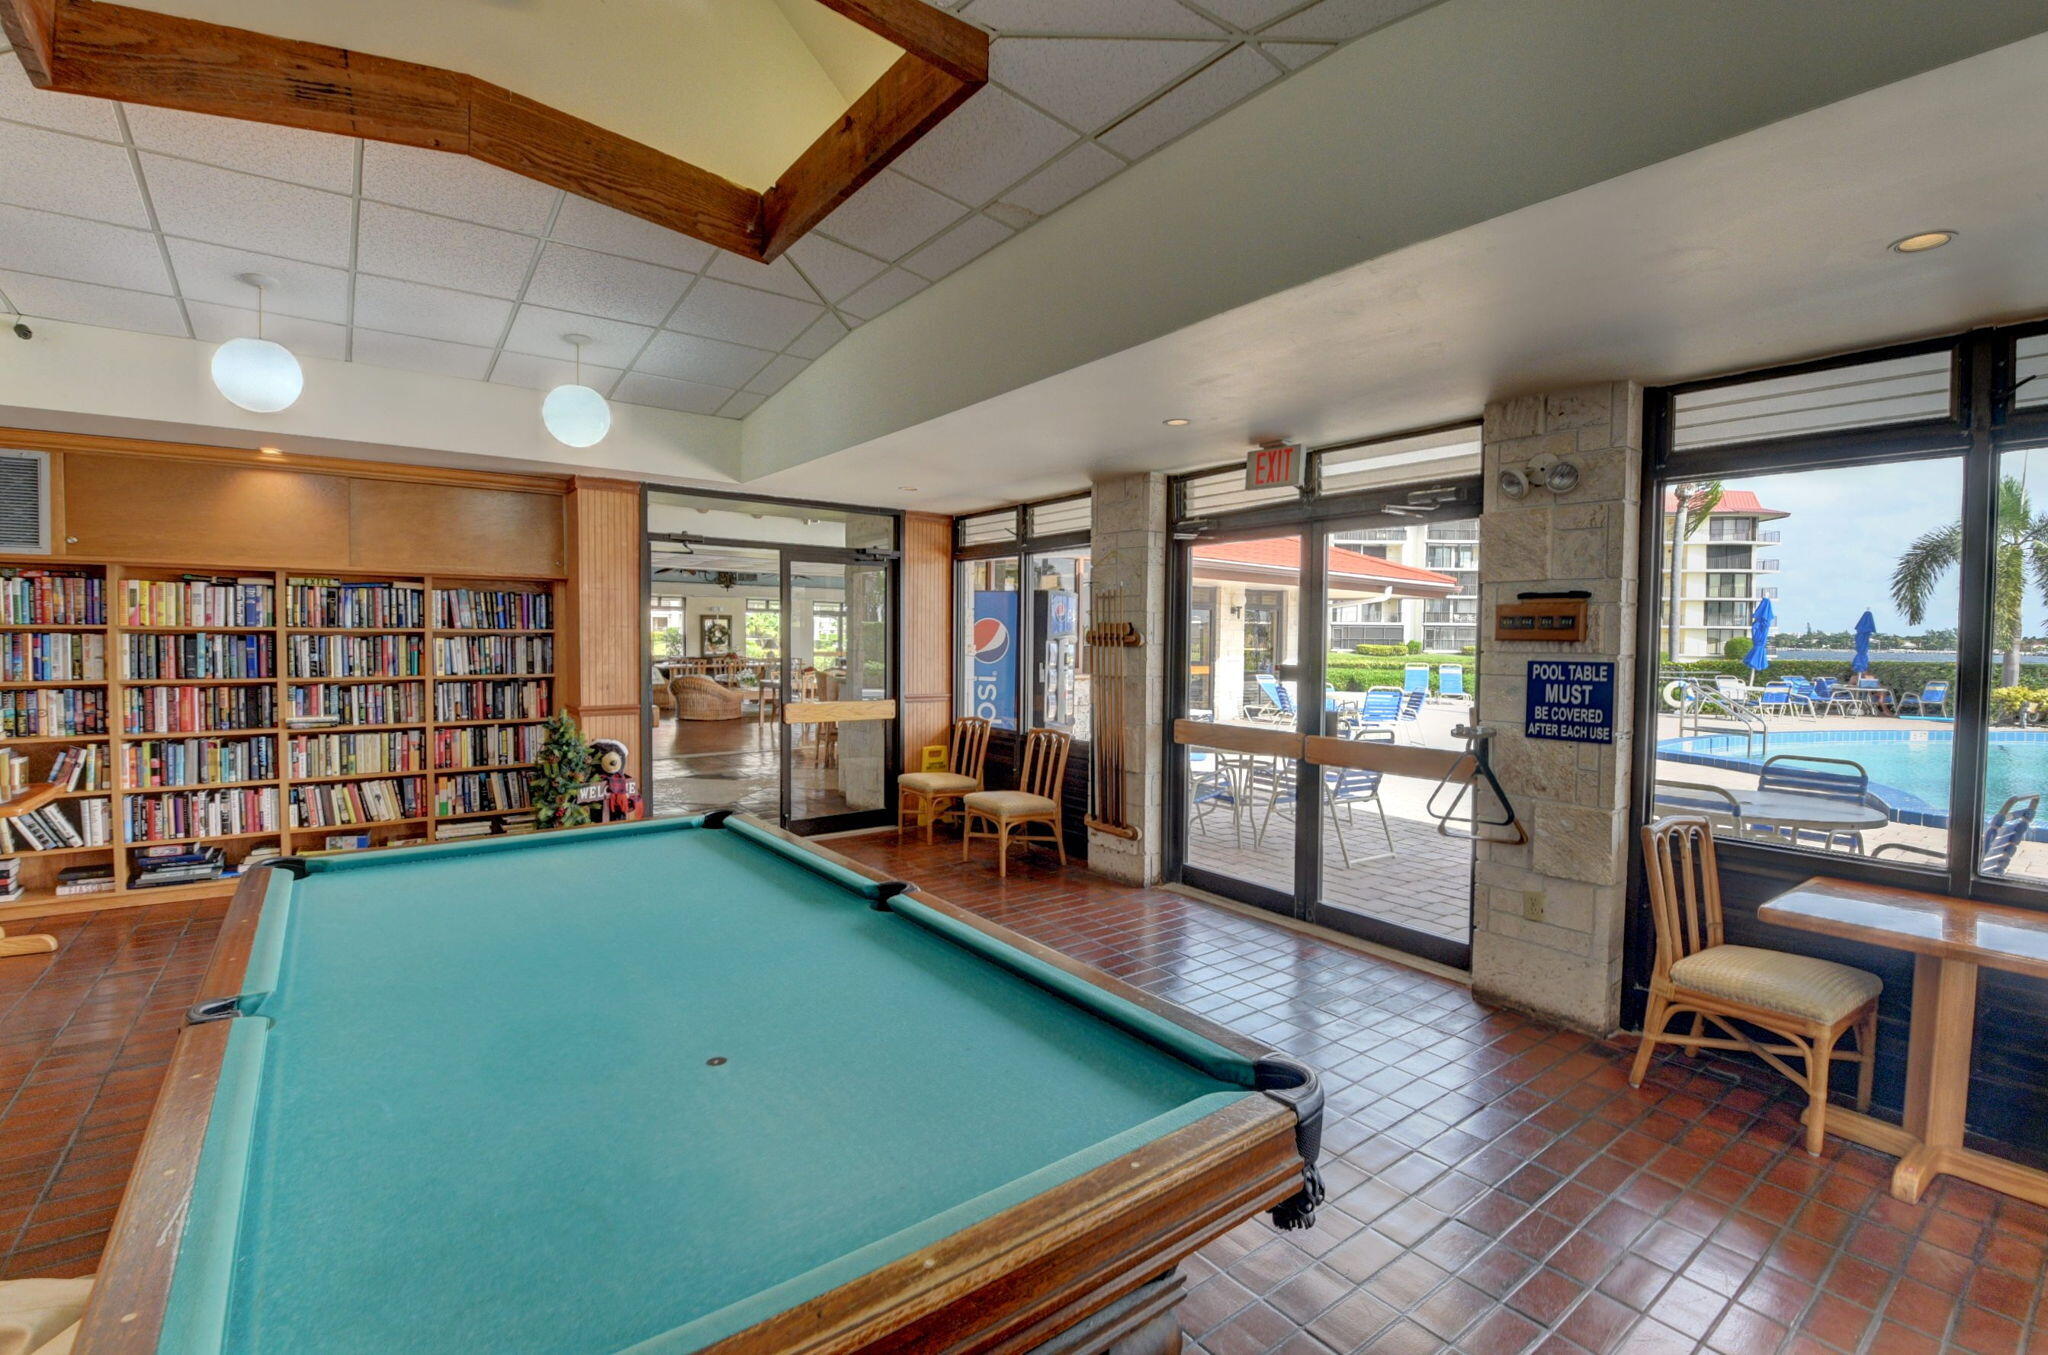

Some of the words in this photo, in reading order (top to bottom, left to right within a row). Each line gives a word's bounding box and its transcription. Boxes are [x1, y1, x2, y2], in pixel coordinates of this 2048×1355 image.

[1255, 448, 1294, 485] EXIT
[1532, 664, 1566, 681] POOL
[1568, 665, 1608, 682] TABLE
[1545, 683, 1593, 705] MUST
[1534, 706, 1549, 720] BE
[1551, 707, 1603, 723] COVERED
[1527, 722, 1559, 736] AFTER
[1560, 724, 1587, 738] EACH
[1589, 727, 1610, 741] USE
[579, 782, 636, 800] WELCE
